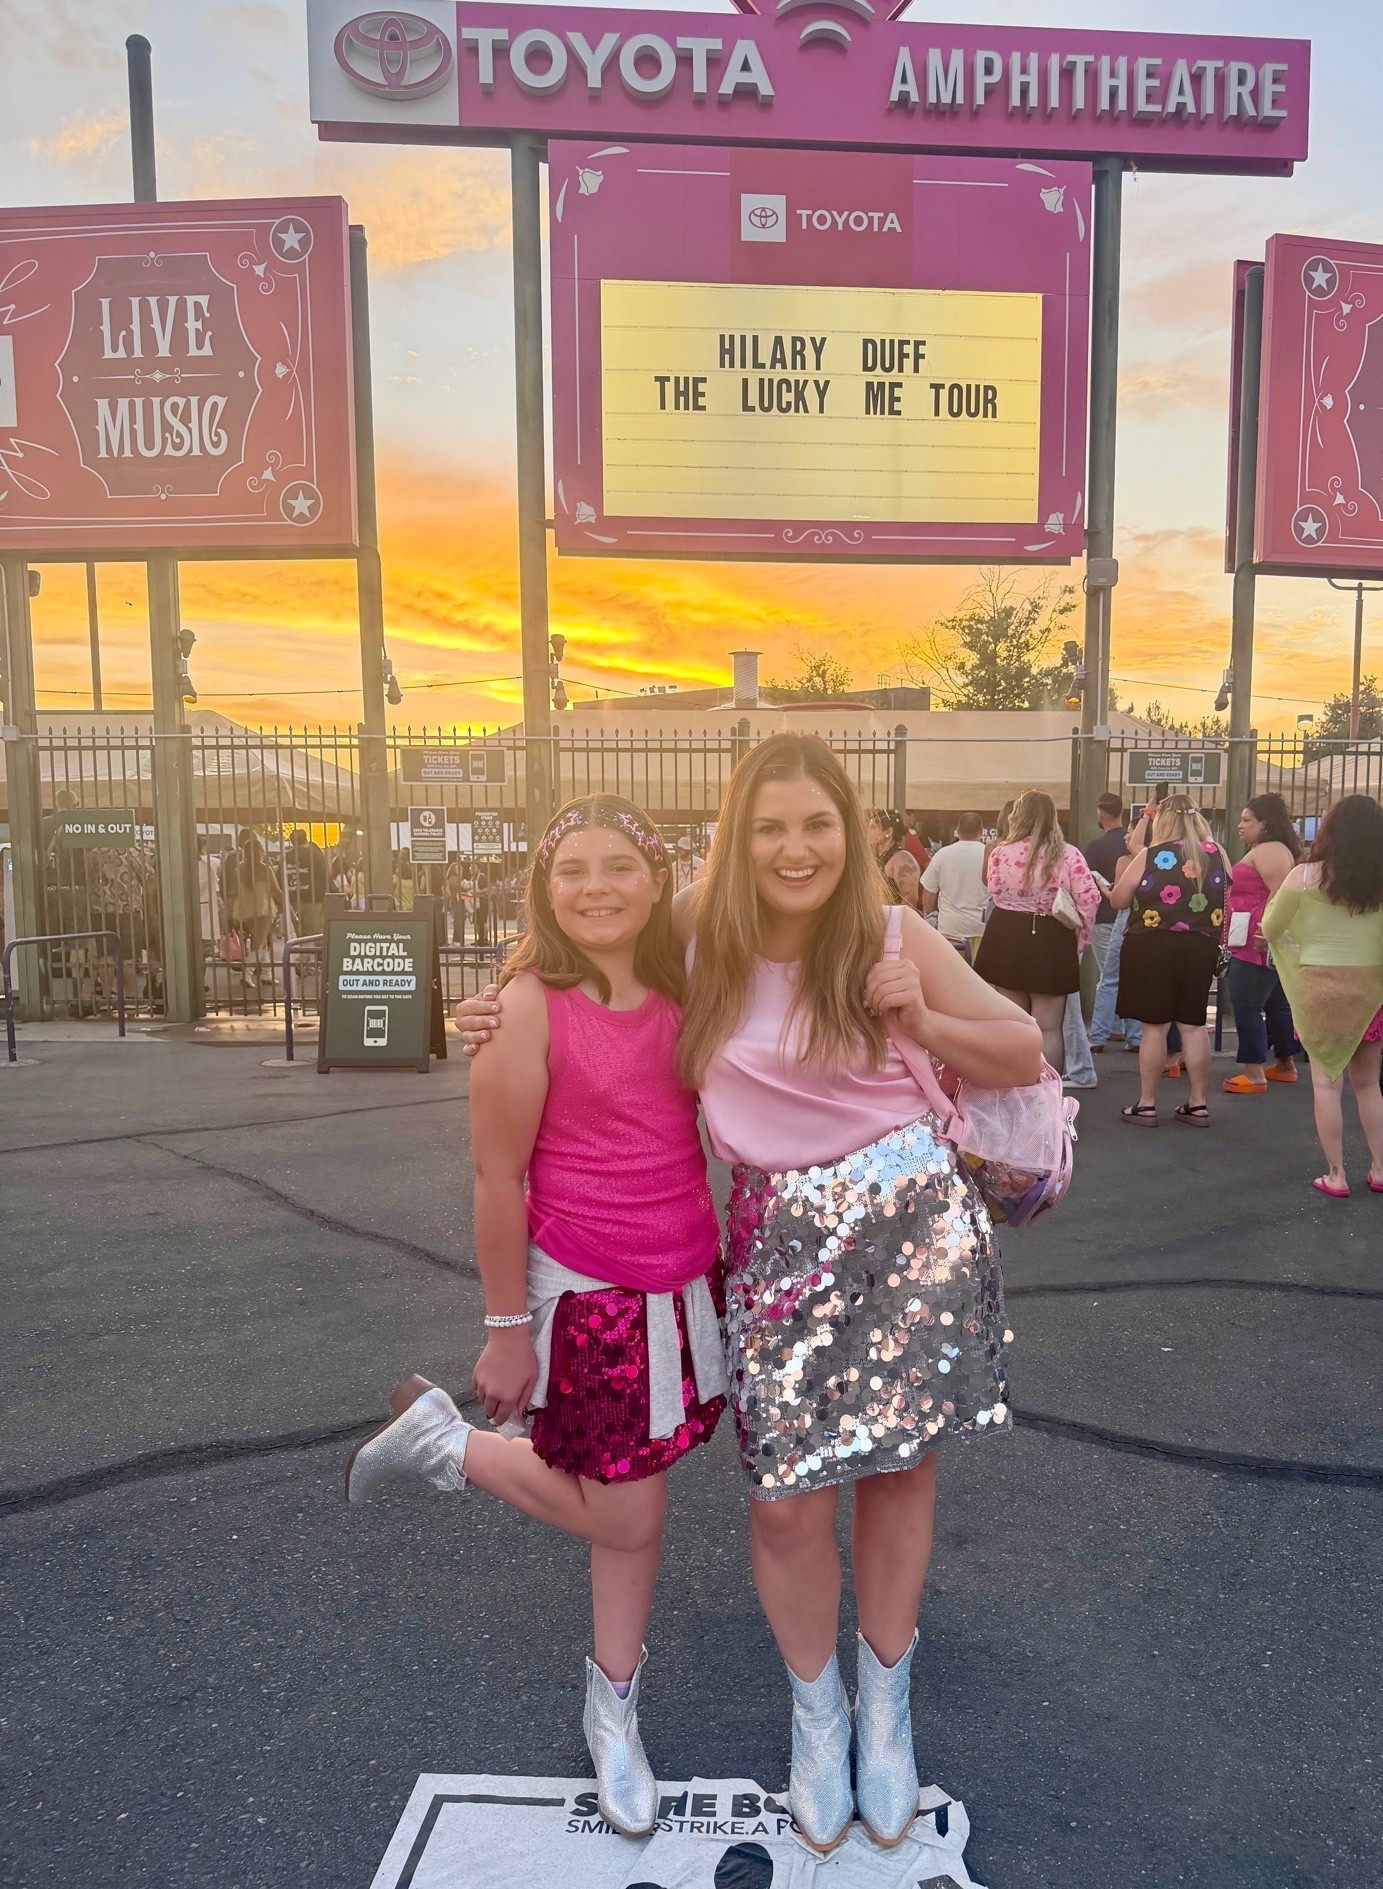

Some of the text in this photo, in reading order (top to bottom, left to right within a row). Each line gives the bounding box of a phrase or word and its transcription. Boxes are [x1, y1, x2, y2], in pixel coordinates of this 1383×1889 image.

[461, 26, 1289, 124] TOYOTA AMPHITHEATRE
[796, 209, 902, 233] TOYOTA
[98, 294, 214, 359] LIVE
[718, 333, 927, 374] HILARY DUFF
[653, 375, 998, 419] THE LUCKY ME TOUR
[94, 394, 229, 459] MUSIC
[423, 755, 460, 764] TICKETS
[1147, 757, 1181, 766] TICKETS
[64, 824, 132, 833] NO IN & OUT
[346, 932, 411, 941] Please Have Your
[350, 942, 408, 956] DIGITAL
[342, 957, 414, 972] BARCODE
[342, 978, 413, 987] OUT AND READY
